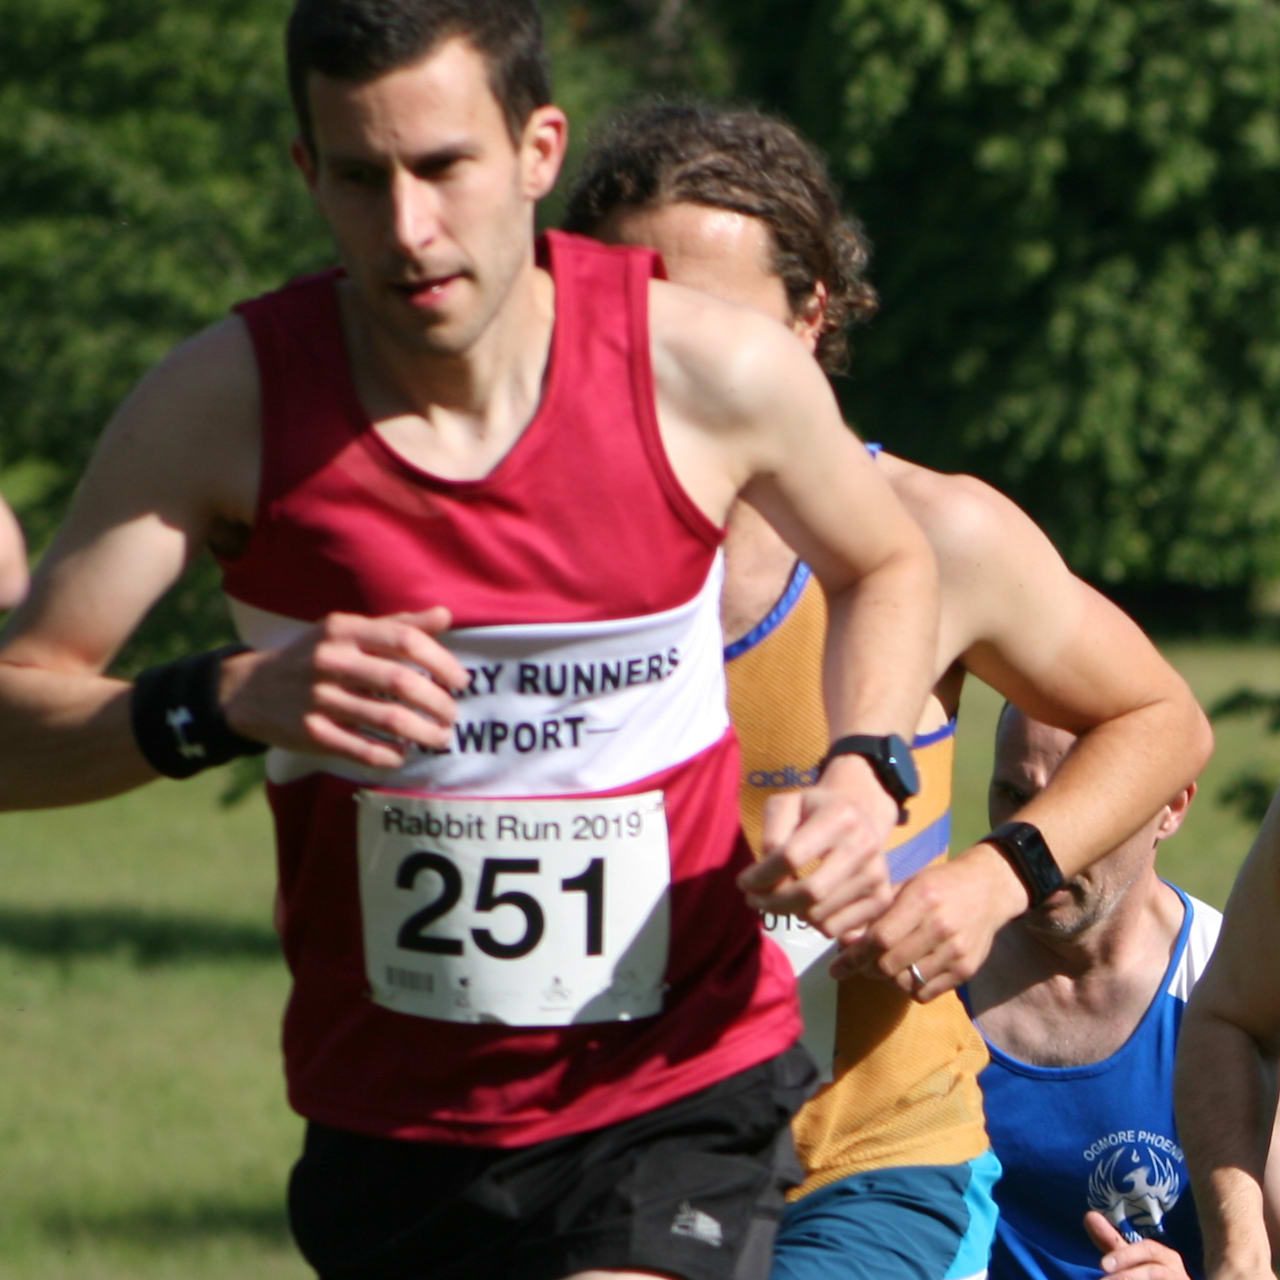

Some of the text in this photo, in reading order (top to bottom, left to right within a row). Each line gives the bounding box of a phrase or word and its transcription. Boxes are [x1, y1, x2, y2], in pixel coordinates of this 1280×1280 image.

[518, 648, 680, 696] RUNNERS
[418, 717, 585, 755] WPORT
[750, 766, 820, 788] adid
[383, 807, 643, 841] Rabbit Run 2019
[395, 851, 605, 961] 251
[1083, 1130, 1136, 1161] OGMORE
